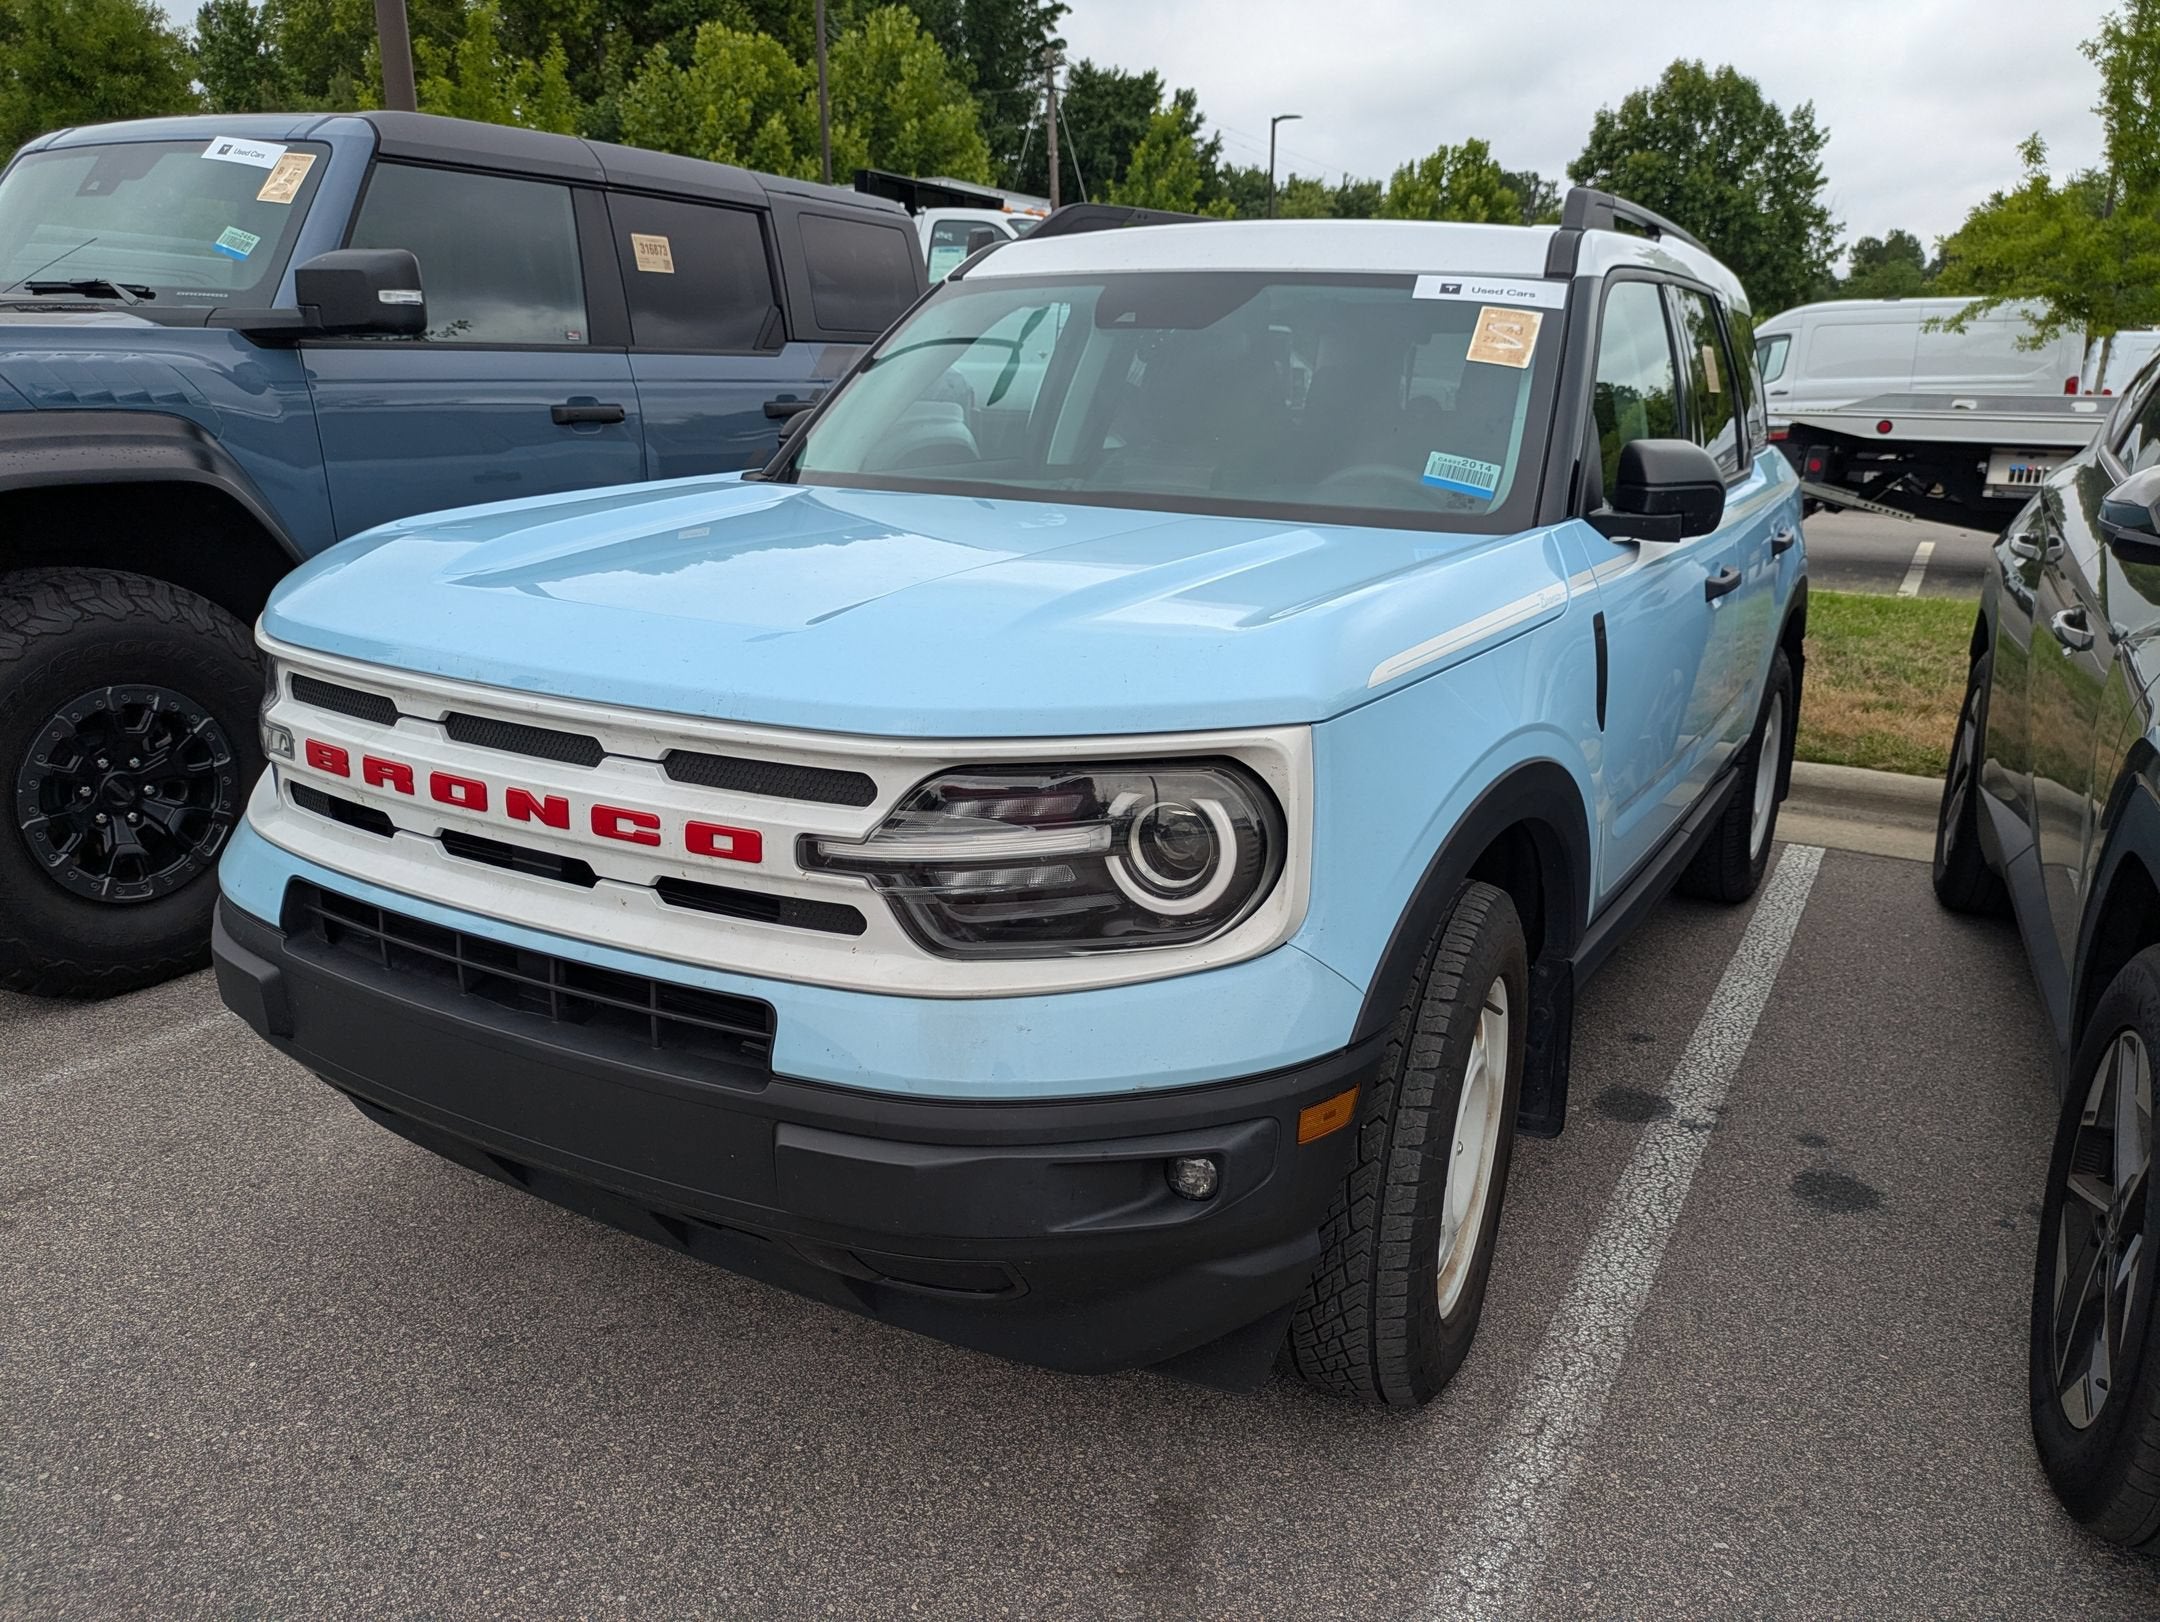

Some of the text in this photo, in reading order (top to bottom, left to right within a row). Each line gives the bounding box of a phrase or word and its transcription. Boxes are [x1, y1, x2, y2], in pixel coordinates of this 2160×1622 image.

[233, 147, 250, 156] Used
[250, 151, 266, 159] Cars
[1471, 286, 1504, 296] Used
[1506, 289, 1536, 298] Cars
[305, 737, 763, 864] BRONCO
